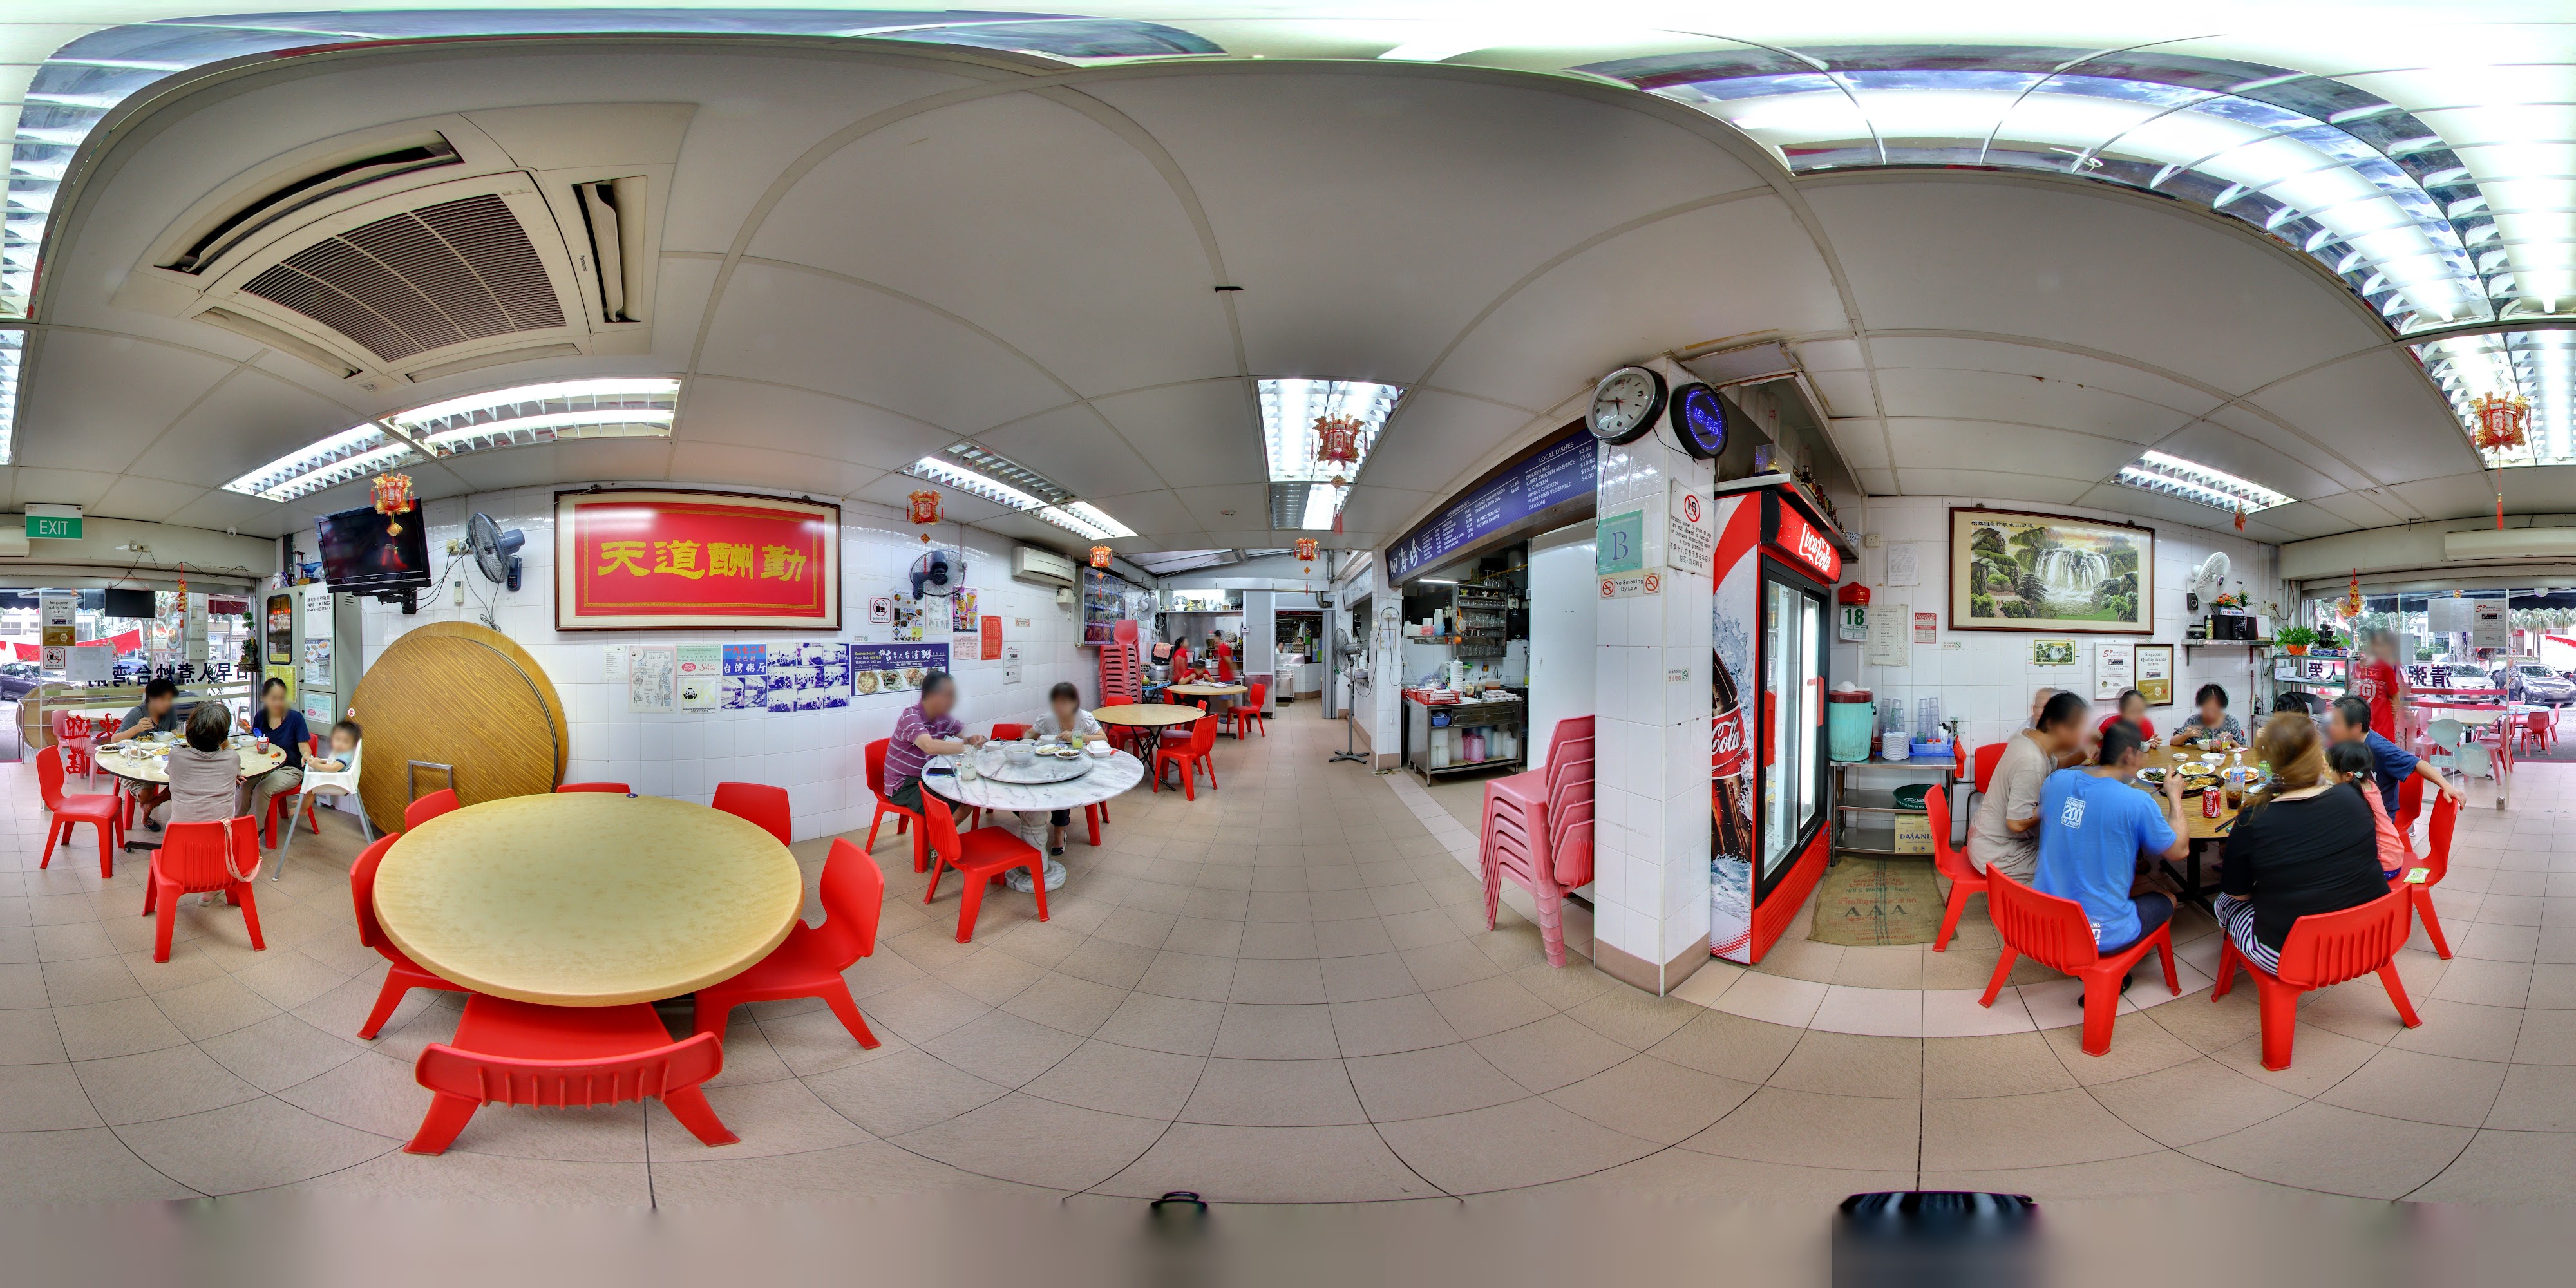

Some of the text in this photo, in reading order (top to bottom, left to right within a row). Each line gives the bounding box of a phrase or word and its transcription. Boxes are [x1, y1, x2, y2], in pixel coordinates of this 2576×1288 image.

[1694, 408, 1719, 435] 18:06
[1525, 445, 1592, 480] CHICKEN RICE $3.00
[1539, 441, 1575, 463] LOCAL DISHES
[1526, 452, 1593, 486] CURRY CHICKEN MEE/RICE $3.00
[1531, 478, 1549, 489] CHICKEN
[1580, 458, 1596, 468] $10.00
[1527, 464, 1596, 498] WHOLE CHICKEN $18.00
[1528, 473, 1595, 504] PLAIN FRIED VEGETABLE $4.00
[1528, 498, 1546, 511] (SEASON)
[39, 520, 69, 535] EXIT
[1488, 513, 1499, 522] CHARGE
[1671, 514, 1681, 524] Persons
[1611, 531, 1629, 561] B
[1675, 531, 1688, 540] consume
[1684, 527, 1694, 536] allowed
[1699, 534, 1710, 543] purchase
[1799, 522, 1832, 573] Coca-Cola
[598, 540, 807, 582] 天道酬勤
[1845, 609, 1864, 625] 18
[724, 662, 766, 674] 台湾粥厅
[1712, 714, 1741, 755] Cola
[2062, 805, 2082, 822] 200
[2205, 792, 2213, 815] Coca-Cola
[1900, 832, 1929, 840] DASANI
